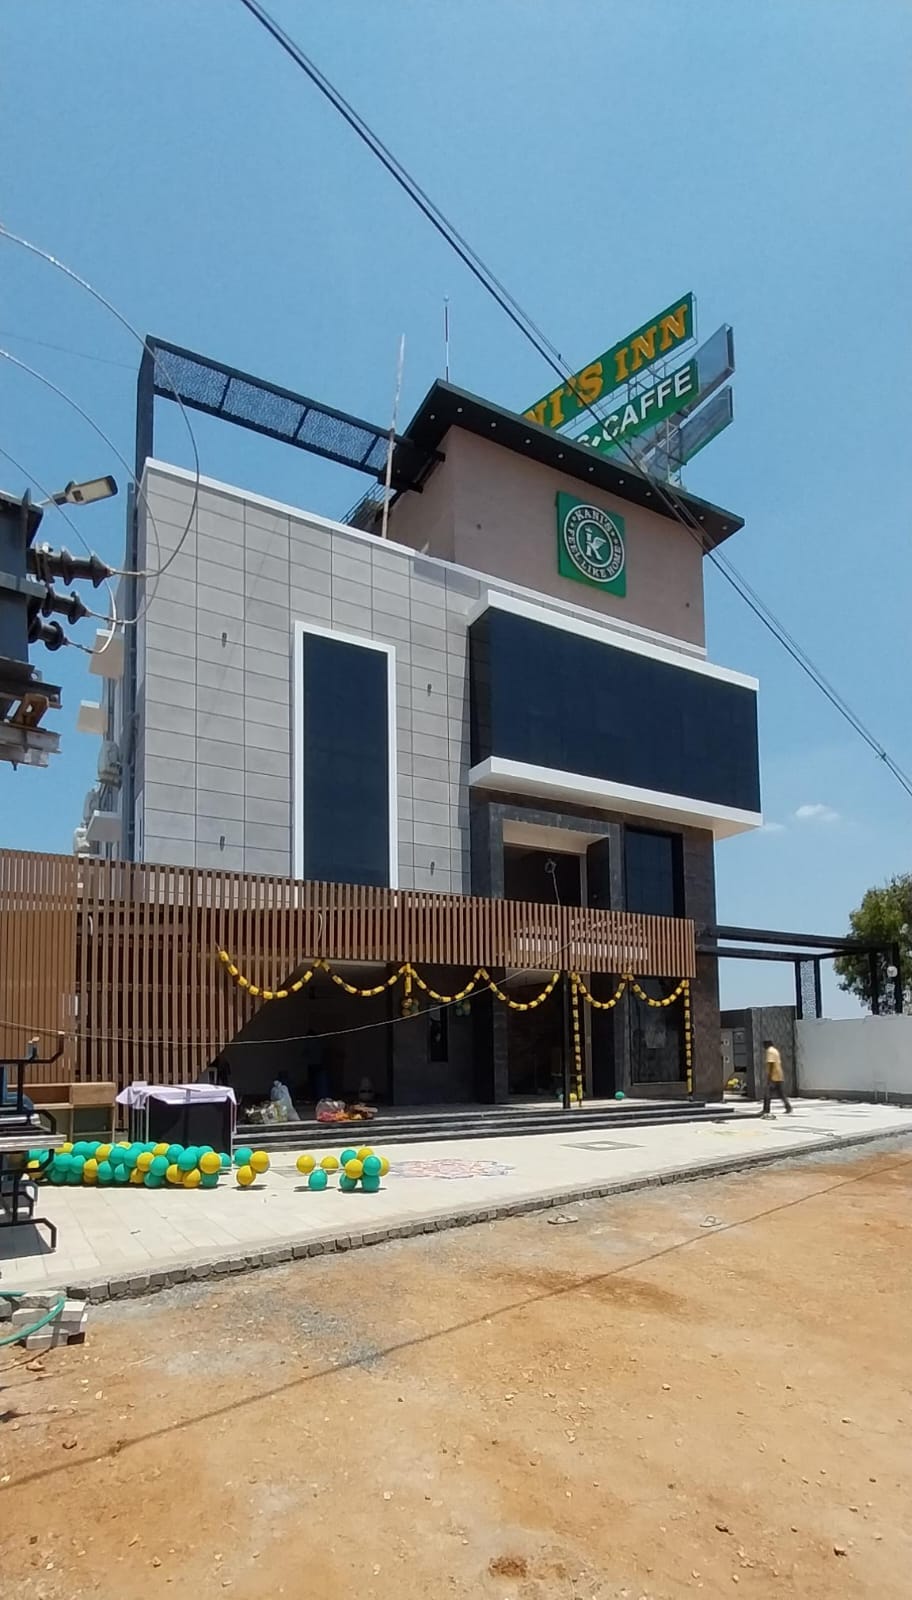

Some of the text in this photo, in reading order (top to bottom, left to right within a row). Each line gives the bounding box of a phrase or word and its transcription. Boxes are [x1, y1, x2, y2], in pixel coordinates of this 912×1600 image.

[614, 304, 687, 382] INN
[575, 508, 612, 533] KANI'S
[568, 528, 621, 578] FEEL LIKE HOME
